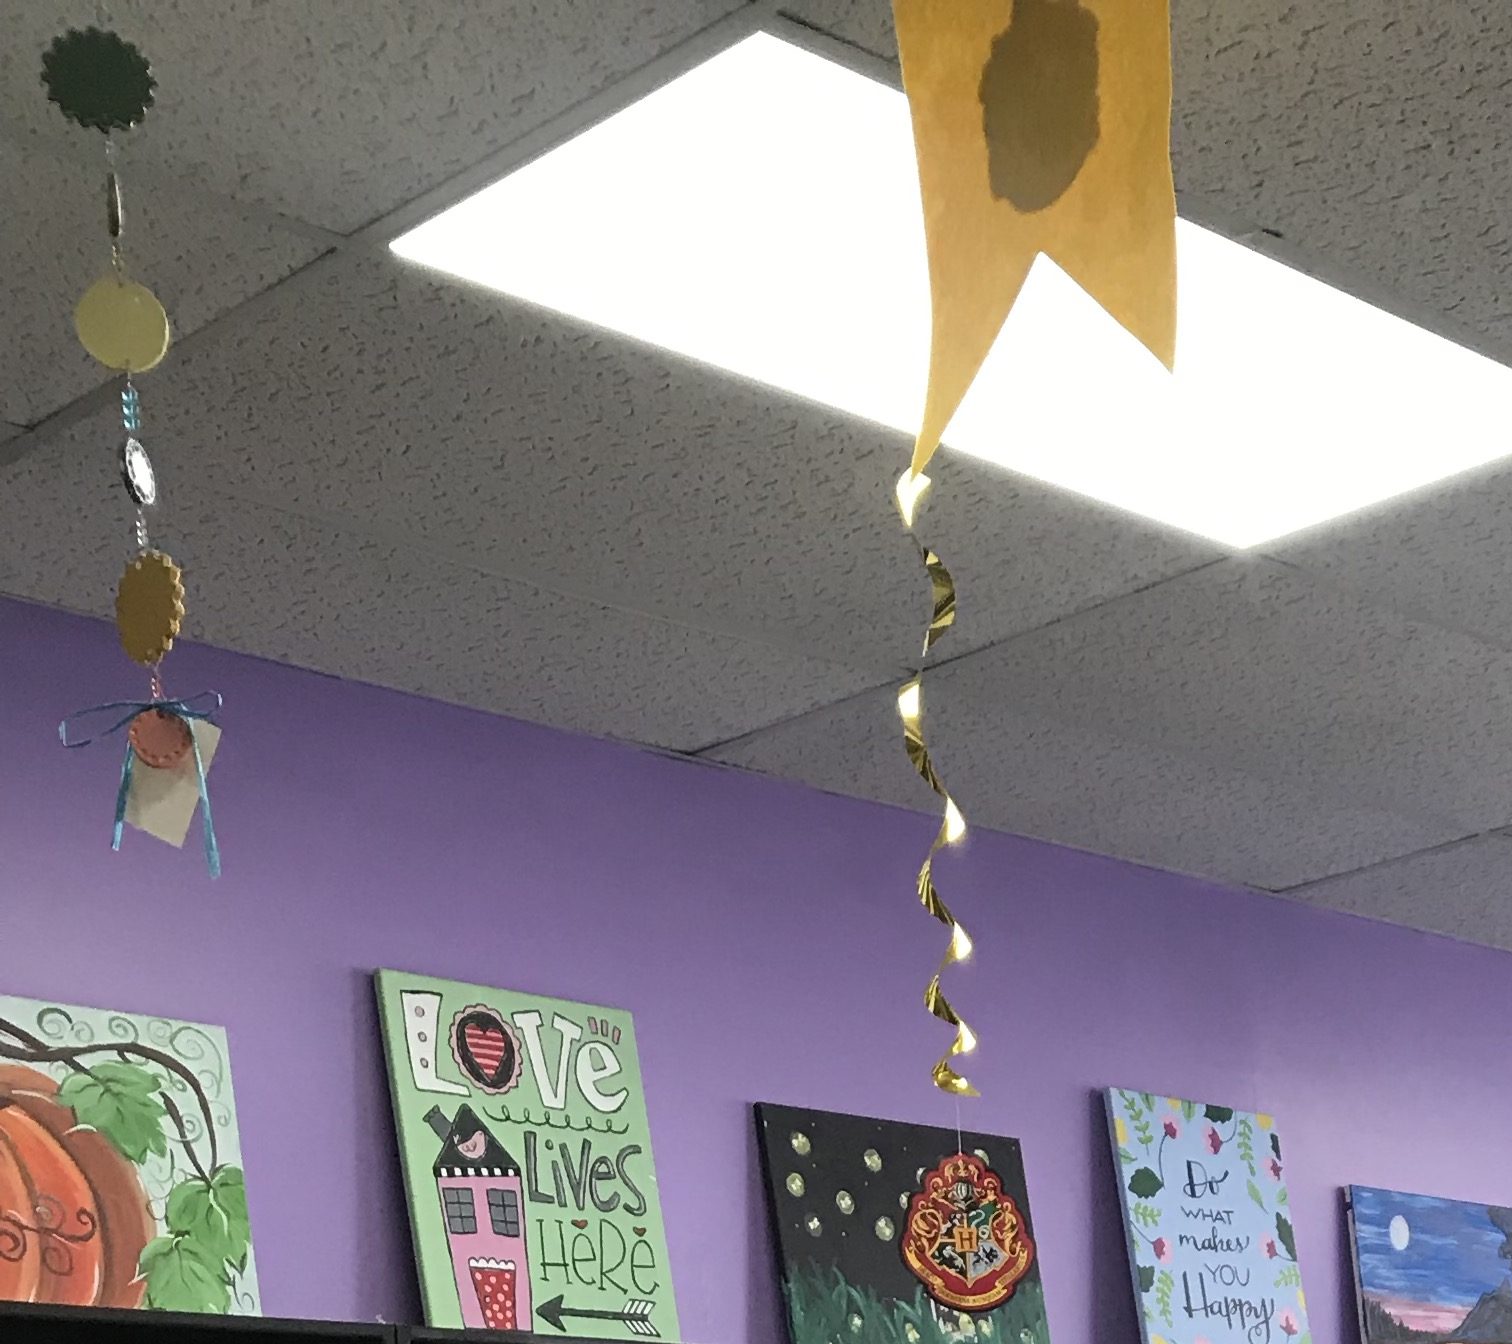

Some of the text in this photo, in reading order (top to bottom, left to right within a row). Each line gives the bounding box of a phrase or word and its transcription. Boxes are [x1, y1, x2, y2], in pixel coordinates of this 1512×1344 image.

[1182, 1159, 1231, 1199] Do
[1179, 1205, 1234, 1227] WHAT
[1178, 1227, 1251, 1254] makes
[1204, 1262, 1251, 1288] YOU
